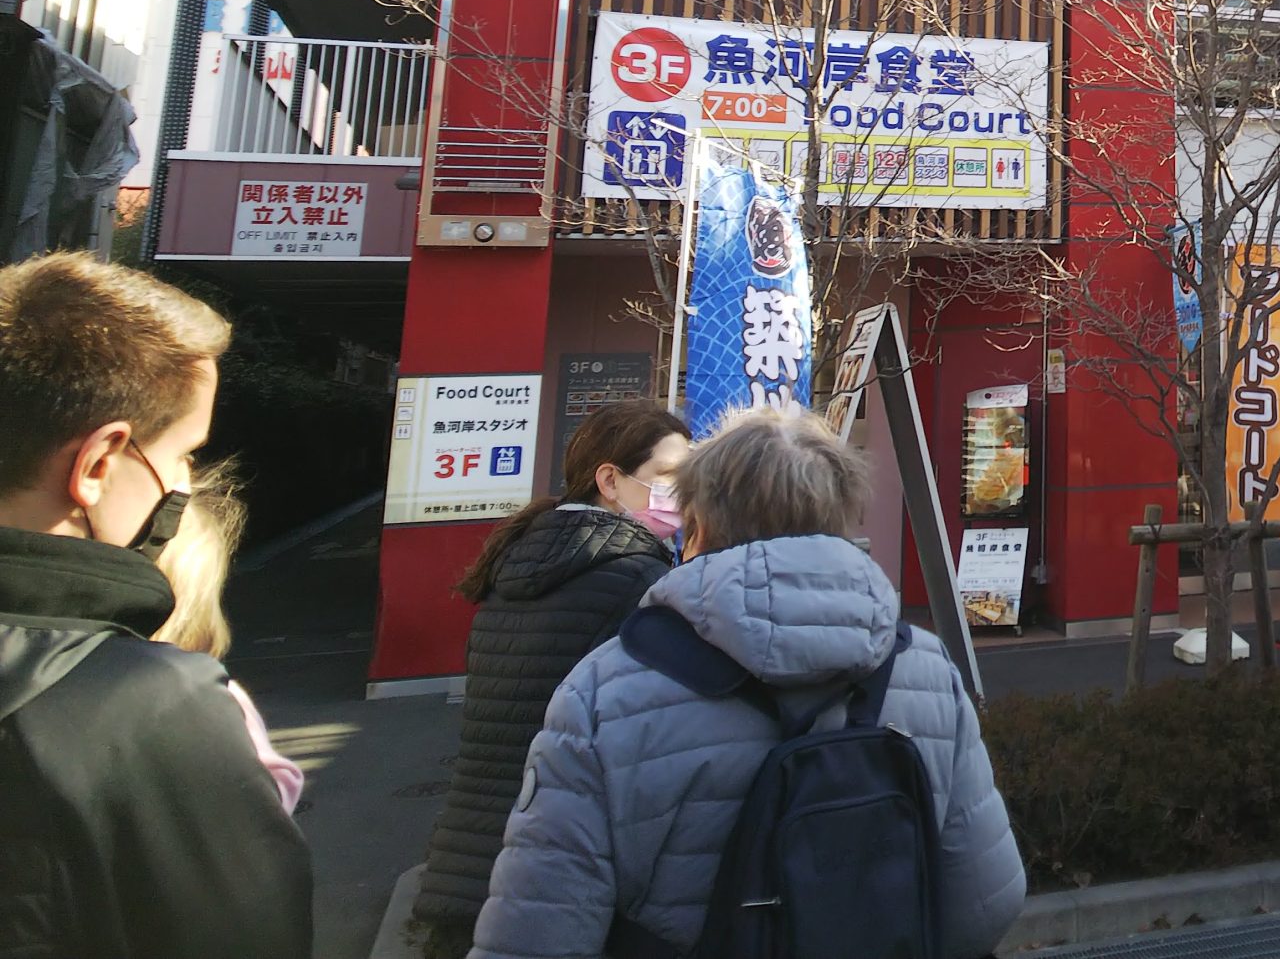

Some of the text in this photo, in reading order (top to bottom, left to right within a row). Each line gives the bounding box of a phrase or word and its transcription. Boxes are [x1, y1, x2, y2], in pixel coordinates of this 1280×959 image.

[618, 44, 687, 84] 3F
[703, 34, 975, 96] 魚河岸食堂
[918, 102, 1031, 135] Court
[241, 184, 364, 204] 関係者以外
[251, 206, 349, 225] 立入禁止
[237, 230, 262, 241] OFF
[265, 231, 298, 241] LIMIT
[568, 361, 590, 374] 3F
[436, 384, 531, 399] Food Court
[432, 418, 529, 434] 魚河岸スタジオ
